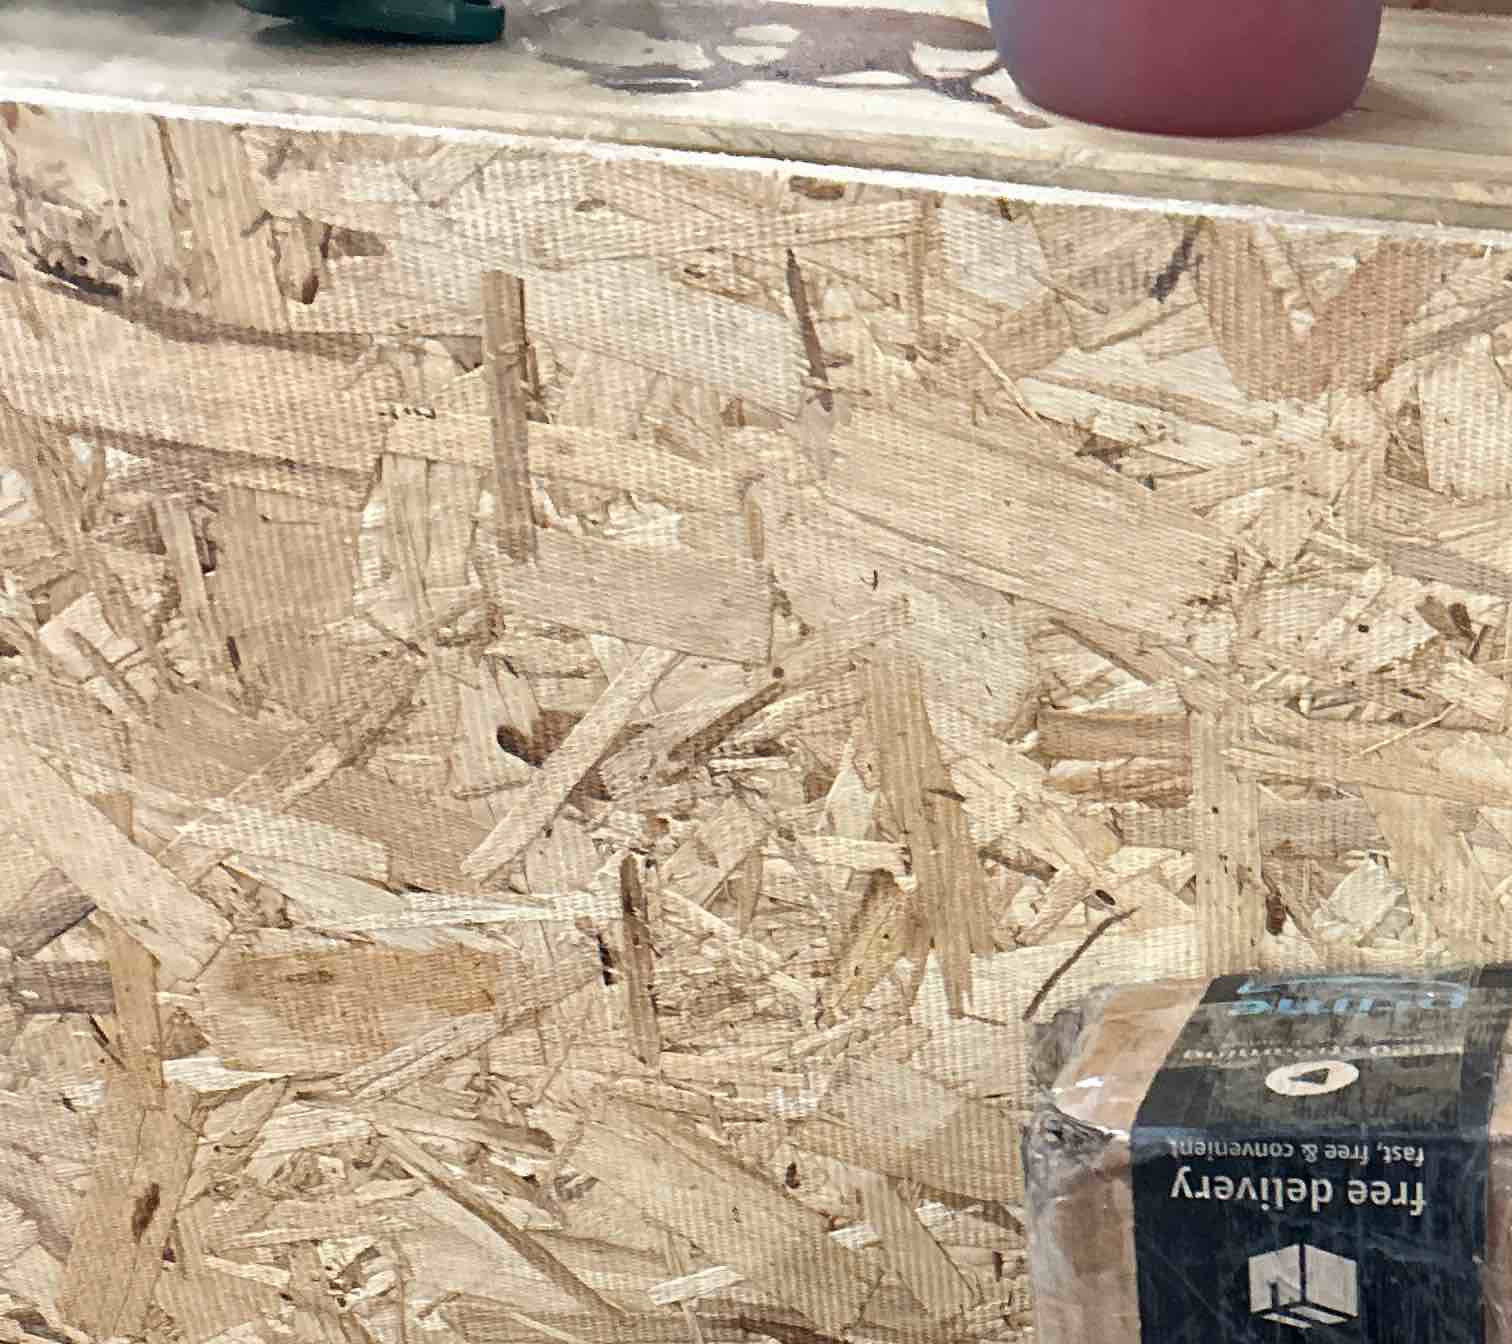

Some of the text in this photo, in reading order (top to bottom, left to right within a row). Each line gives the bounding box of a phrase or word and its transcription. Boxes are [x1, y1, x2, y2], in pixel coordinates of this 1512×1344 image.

[1168, 1138, 1425, 1167] fast, free & convenient
[1169, 1165, 1426, 1216] free delivery
